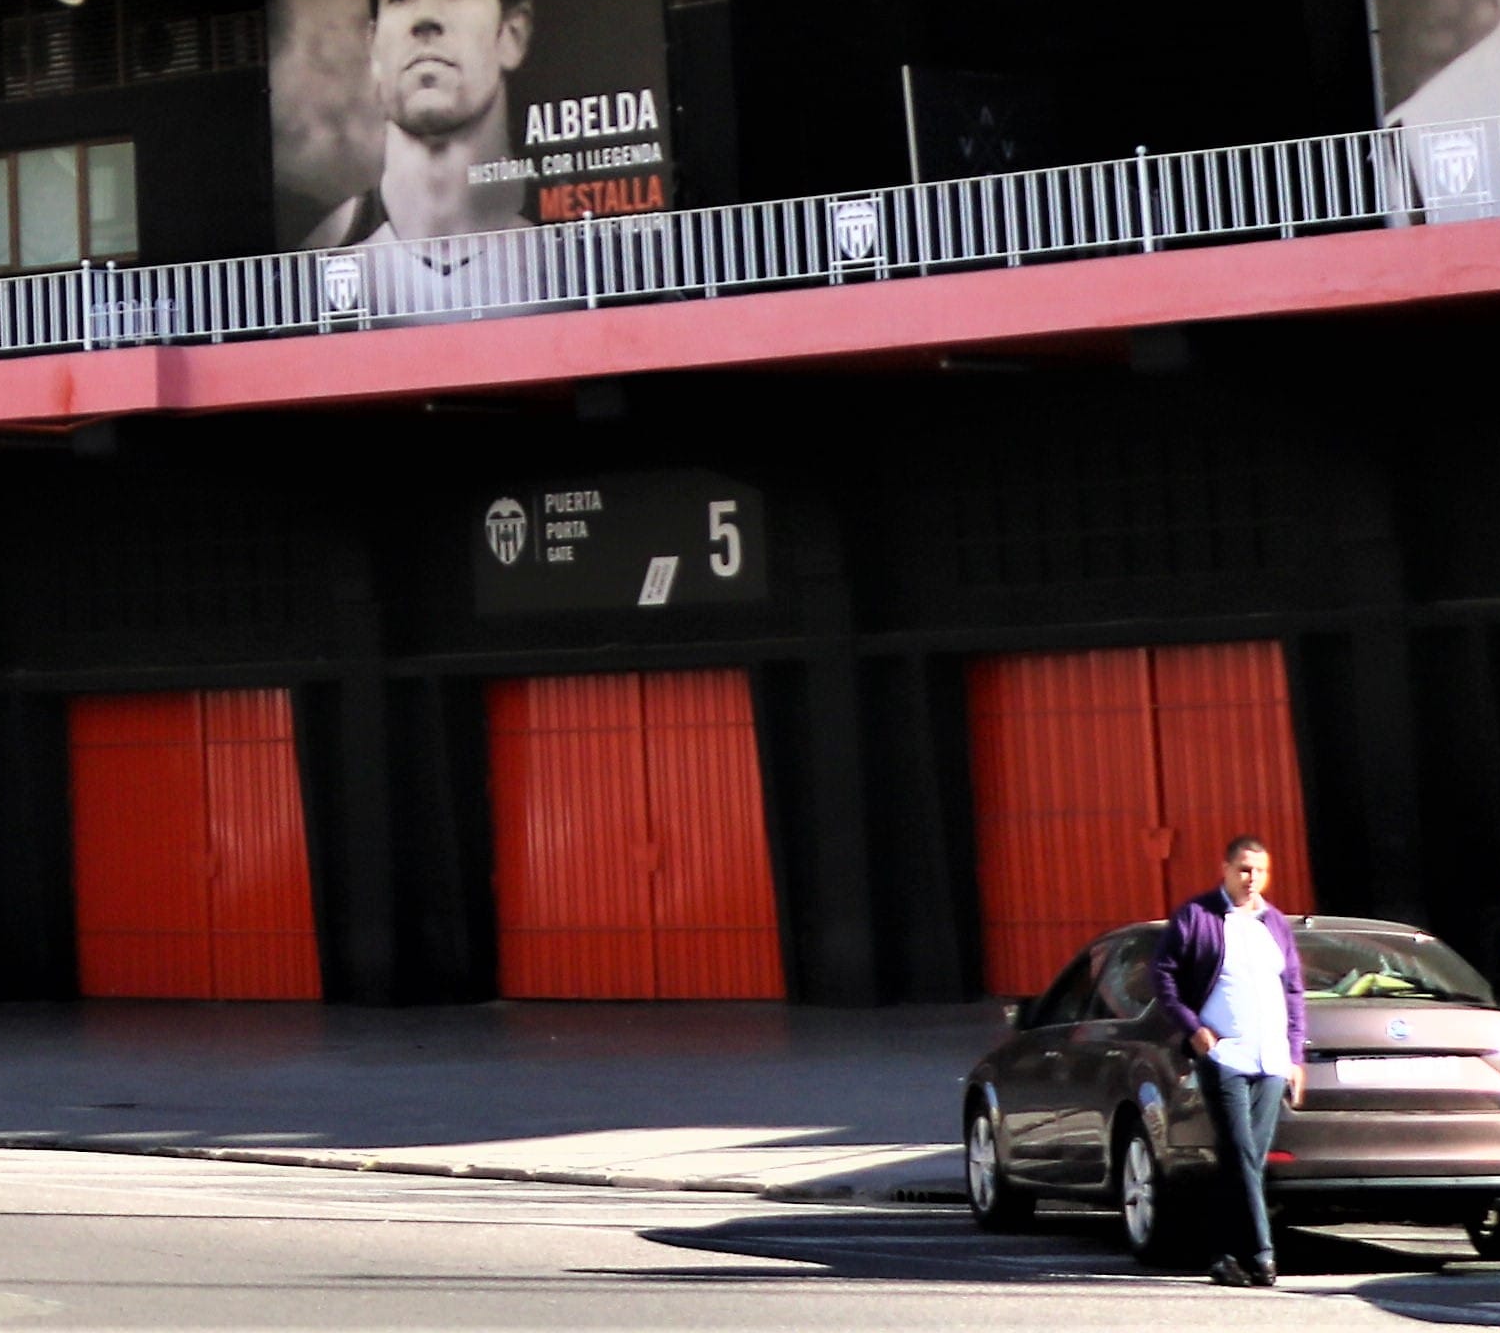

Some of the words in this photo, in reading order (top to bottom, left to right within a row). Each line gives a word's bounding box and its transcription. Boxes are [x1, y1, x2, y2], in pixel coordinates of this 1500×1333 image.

[525, 88, 659, 145] ALBELDA
[539, 174, 665, 221] MESTALLA
[545, 490, 603, 514] PUERTA
[546, 520, 589, 540] PORTA
[708, 499, 742, 578] 5
[547, 546, 575, 562] GATE
